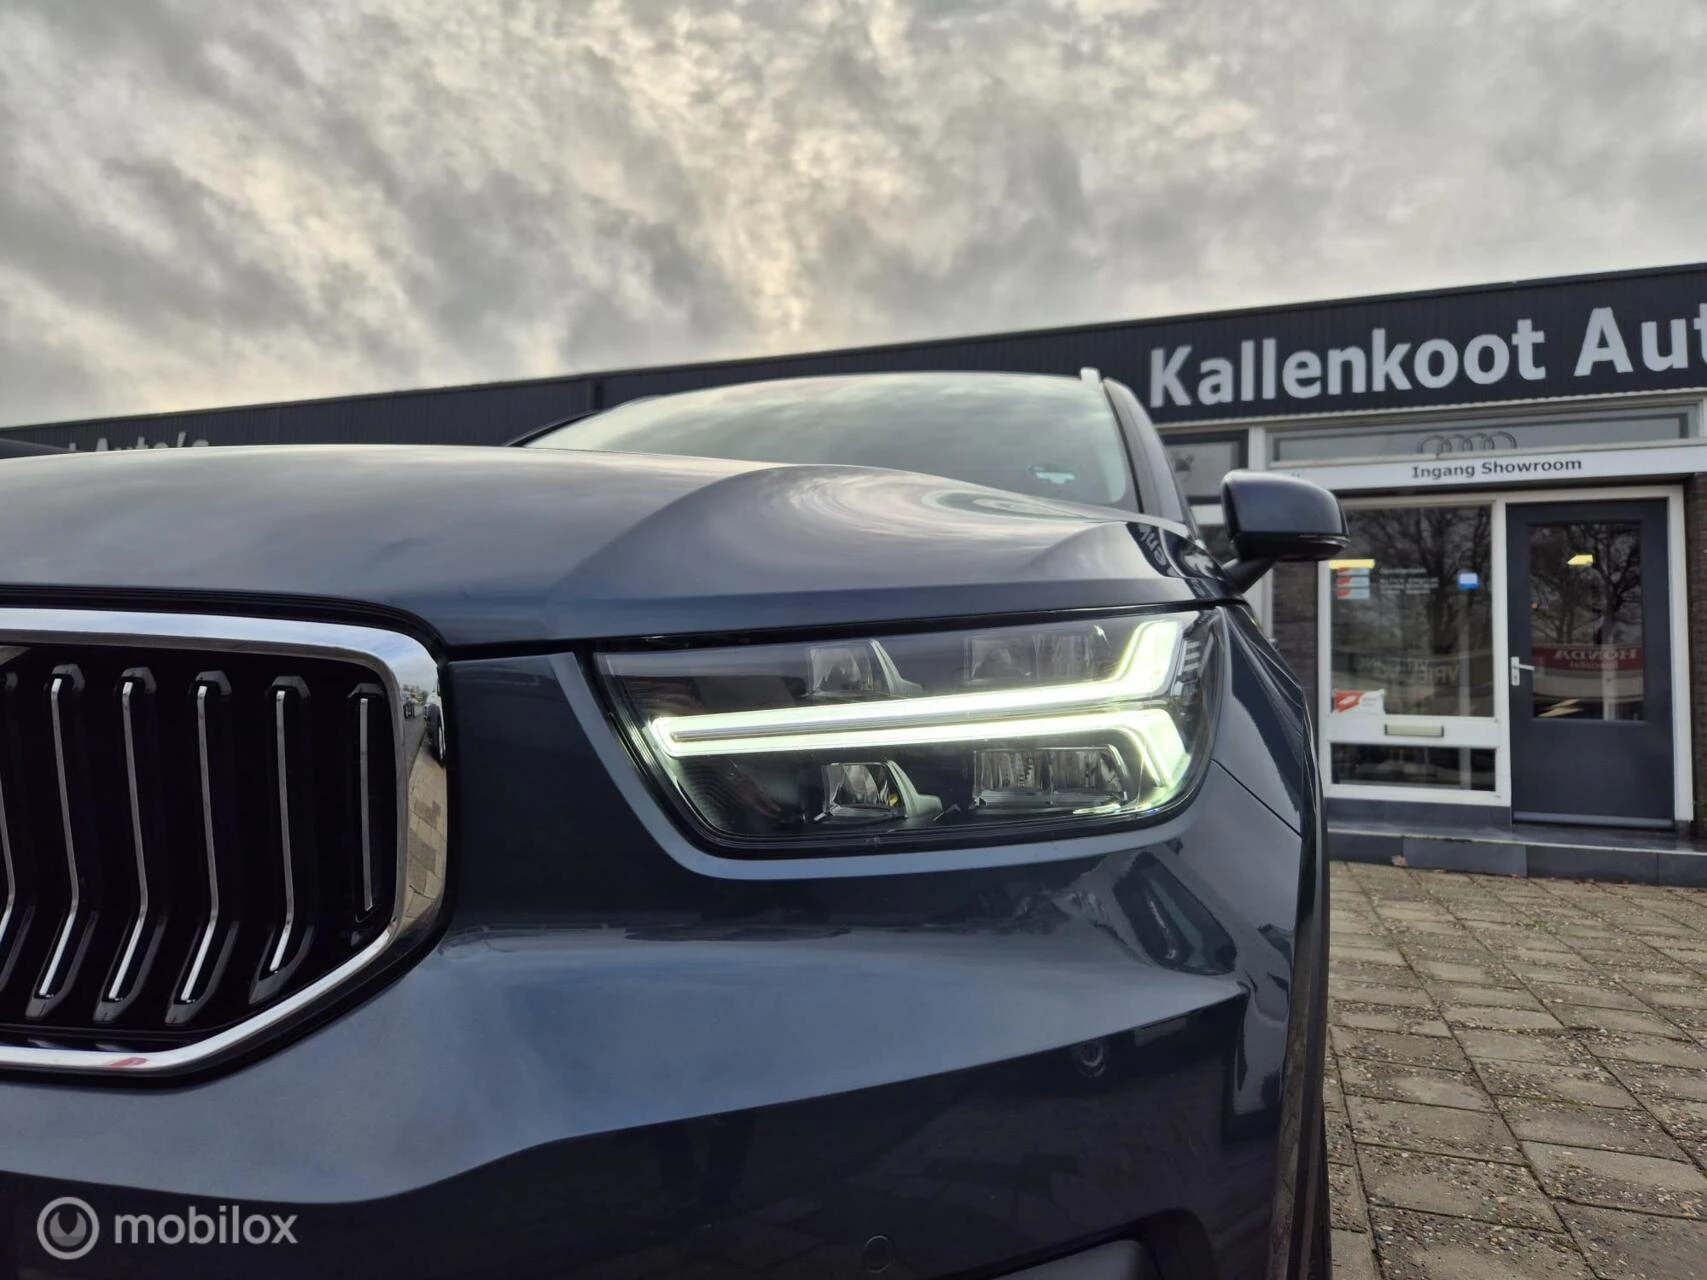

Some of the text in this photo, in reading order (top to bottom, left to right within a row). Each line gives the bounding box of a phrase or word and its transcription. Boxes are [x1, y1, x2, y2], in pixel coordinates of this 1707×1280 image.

[1150, 318, 1547, 408] Kallenkoot
[1411, 459, 1582, 480] Ingang Showroom
